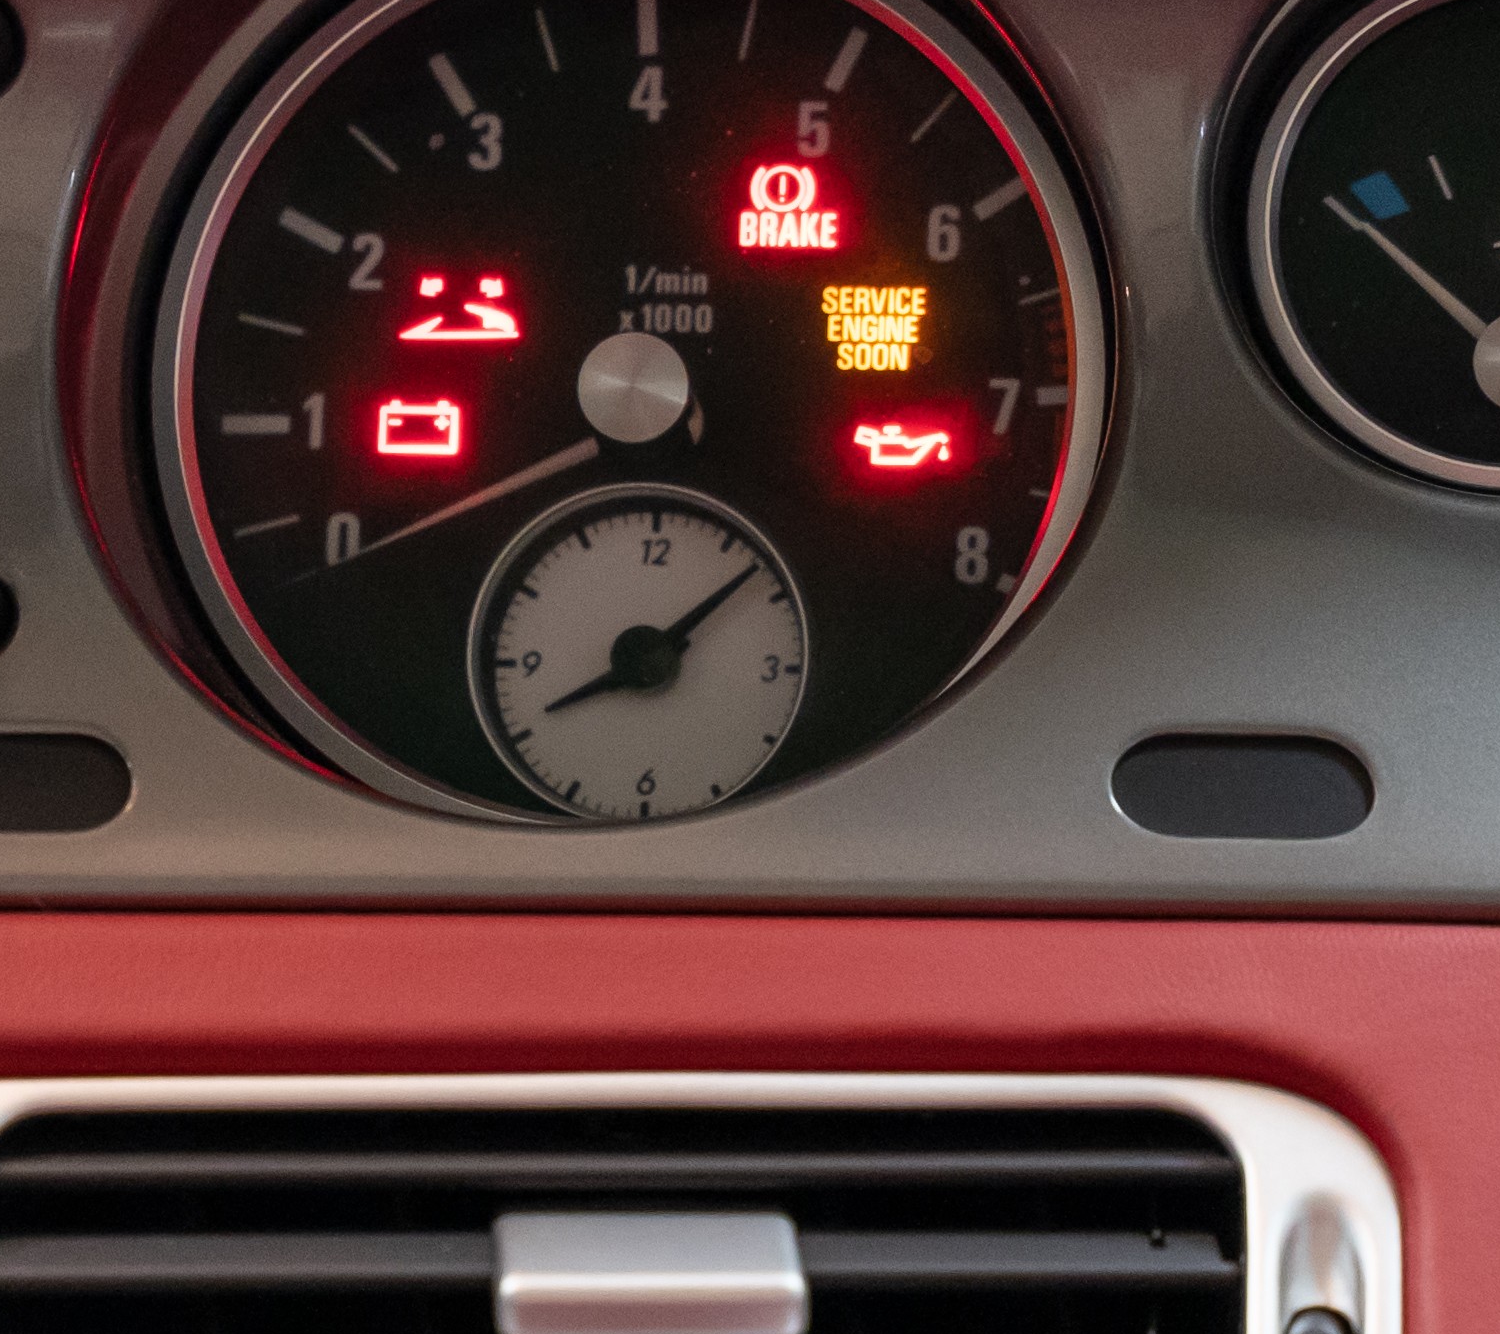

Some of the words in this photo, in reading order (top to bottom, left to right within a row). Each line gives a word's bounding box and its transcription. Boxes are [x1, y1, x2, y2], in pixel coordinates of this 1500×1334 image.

[629, 66, 668, 122] 4
[468, 112, 503, 170] 3
[798, 101, 830, 157] 5
[739, 210, 838, 248] BRAKE
[926, 205, 960, 262] 6
[348, 233, 384, 290] 2
[625, 264, 708, 295] 1/min
[821, 286, 927, 315] SERVICE
[827, 315, 919, 343] ENGINE
[836, 342, 910, 371] SOON
[303, 393, 325, 450] 1
[989, 378, 1020, 435] 7
[326, 512, 361, 566] 0
[641, 539, 671, 566] 12
[955, 526, 990, 585] 8
[522, 651, 542, 677] 9
[761, 655, 780, 682] 3
[636, 768, 656, 795] 6
